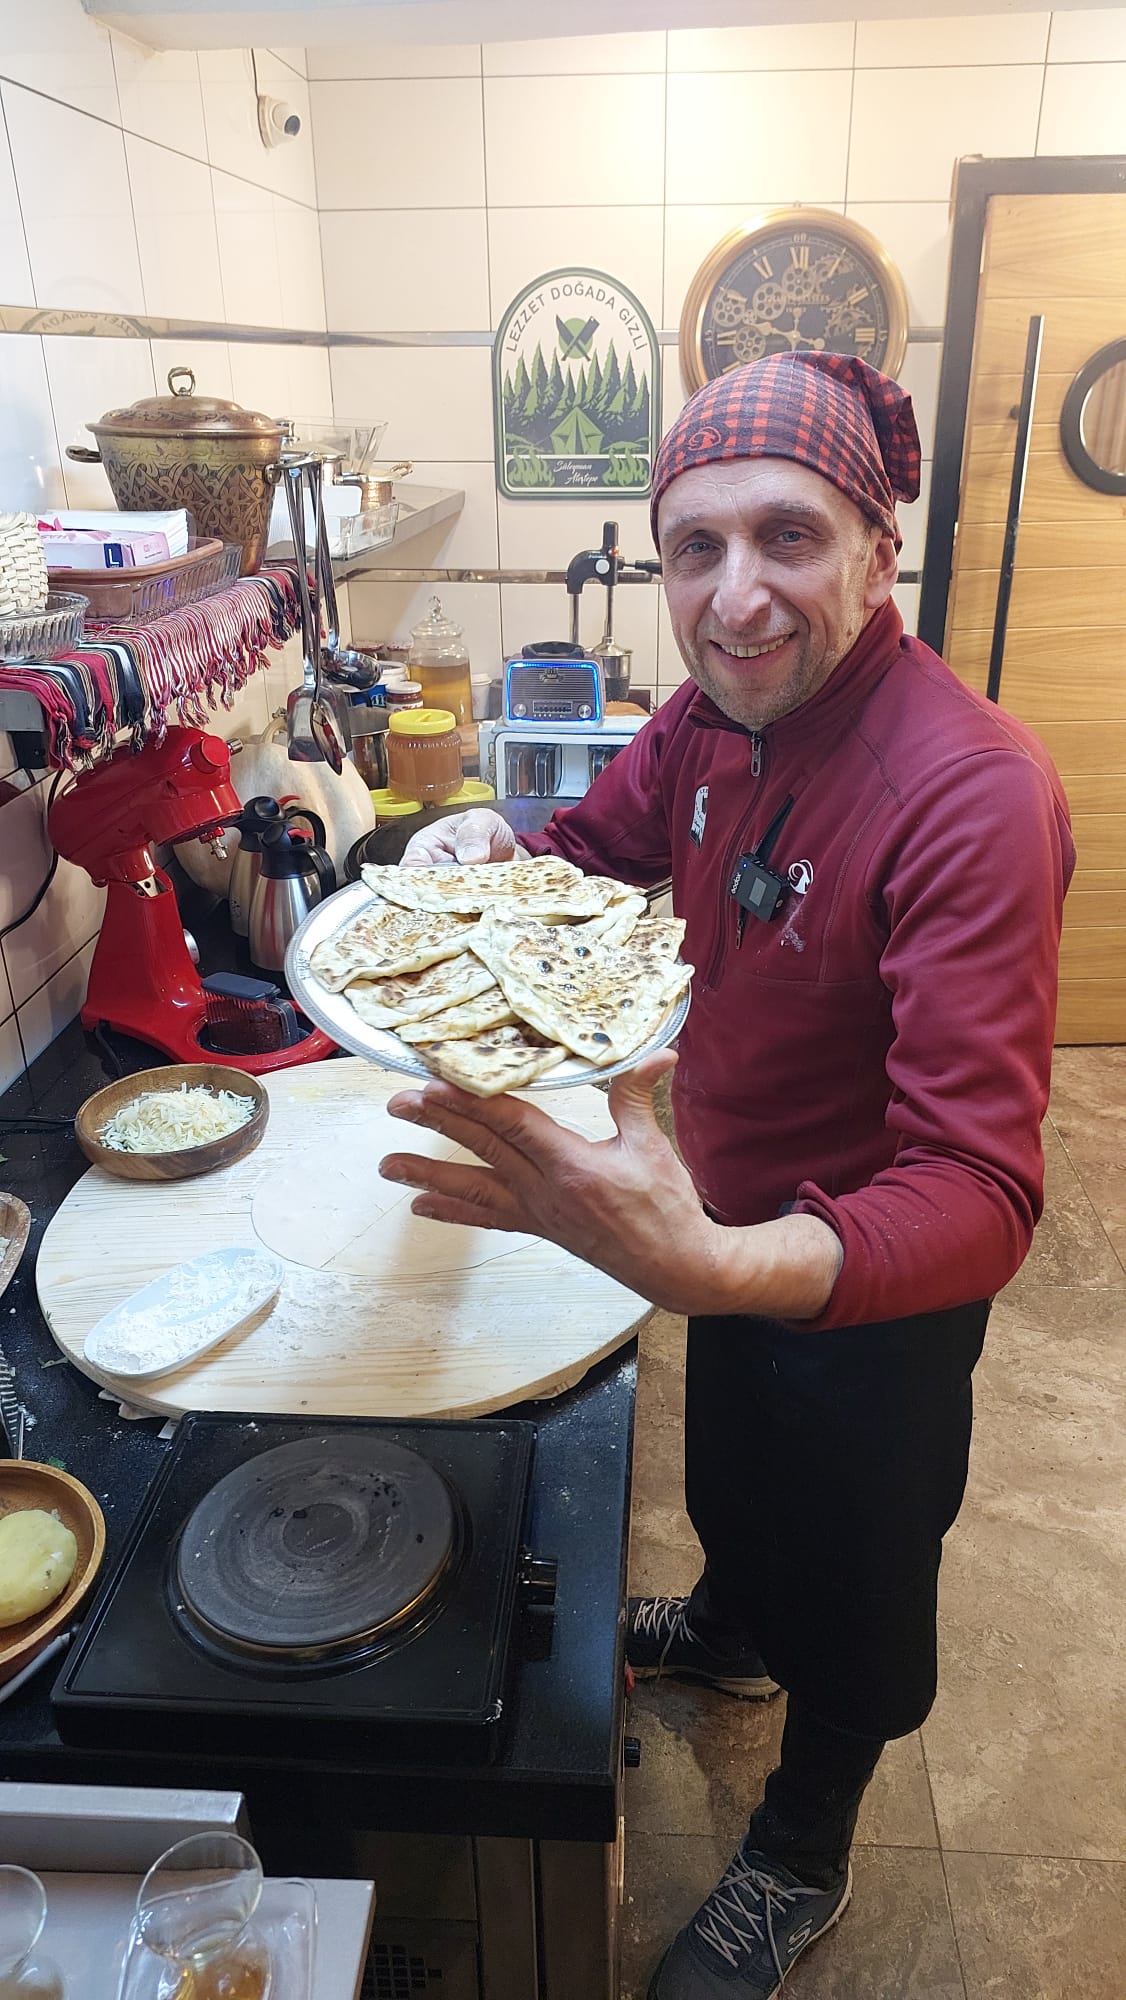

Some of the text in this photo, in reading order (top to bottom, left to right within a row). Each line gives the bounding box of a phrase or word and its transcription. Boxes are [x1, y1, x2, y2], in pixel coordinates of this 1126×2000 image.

[506, 280, 648, 353] LEZZET DOĞADA GİZLİ
